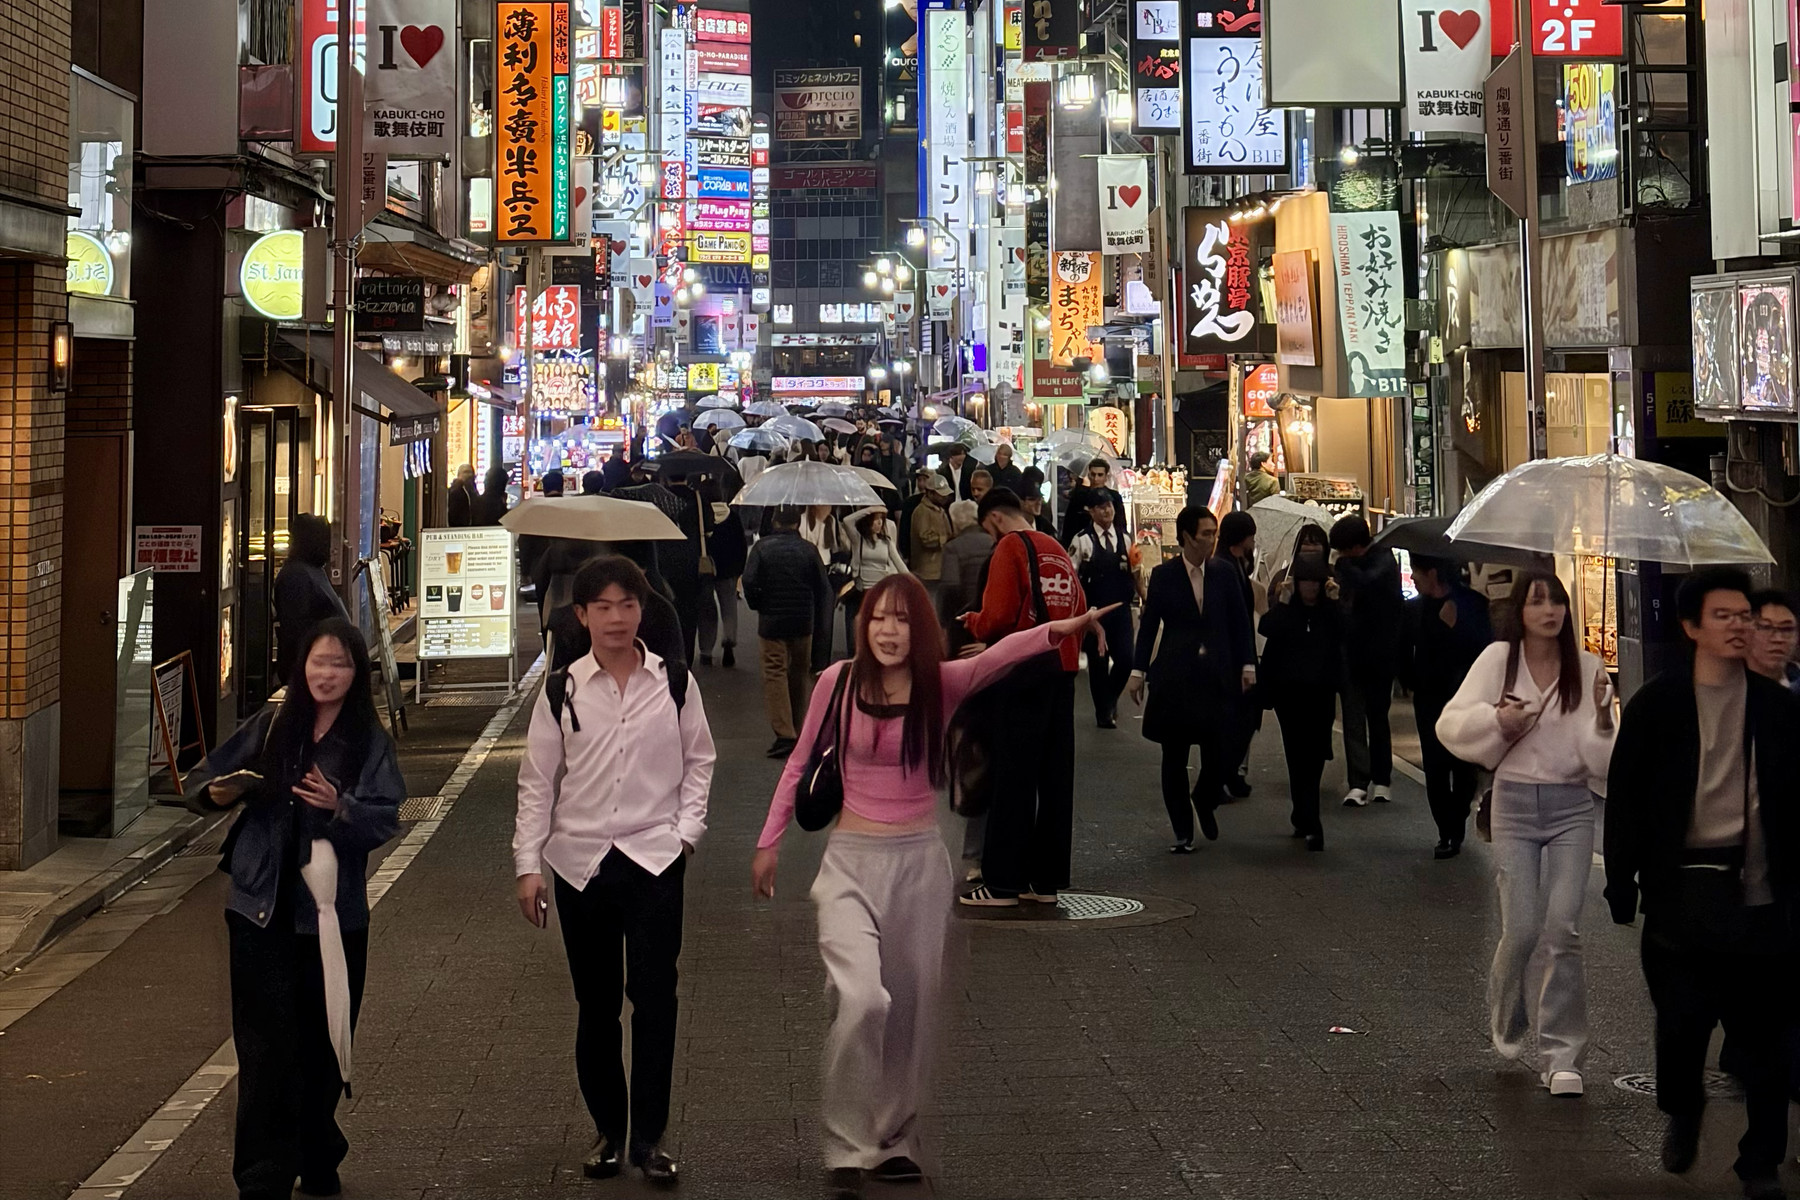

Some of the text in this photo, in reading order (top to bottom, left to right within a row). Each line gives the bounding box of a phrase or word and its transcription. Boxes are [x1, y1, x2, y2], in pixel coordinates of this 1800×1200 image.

[554, 9, 569, 66] 炭火串焼
[1417, 10, 1438, 52] I
[1541, 20, 1595, 51] 2F
[378, 25, 398, 70] I
[1007, 78, 1024, 88] MEAT
[1569, 64, 1590, 113] 50
[1417, 89, 1483, 99] KABUKI-CHO
[1211, 46, 1248, 163] うまいもん
[1418, 101, 1483, 118] 歌舞伎町
[373, 110, 445, 119] KABUKI-CHO
[373, 121, 445, 138] 歌舞伎町
[1496, 86, 1514, 181] 劇場通り一番街
[1197, 119, 1212, 163] 一番街
[1252, 150, 1283, 163] B1F
[1107, 185, 1118, 210] I
[697, 234, 739, 250] GAME PANIC
[1107, 236, 1144, 247] 歌舞伎町
[1336, 224, 1350, 277] HIROSHIMA
[1007, 246, 1015, 264] I
[705, 266, 750, 285] AUNA
[931, 285, 938, 298] I
[1357, 223, 1403, 355] お好み焼き
[1036, 377, 1061, 386] ONLINE
[1379, 377, 1408, 393] B1F
